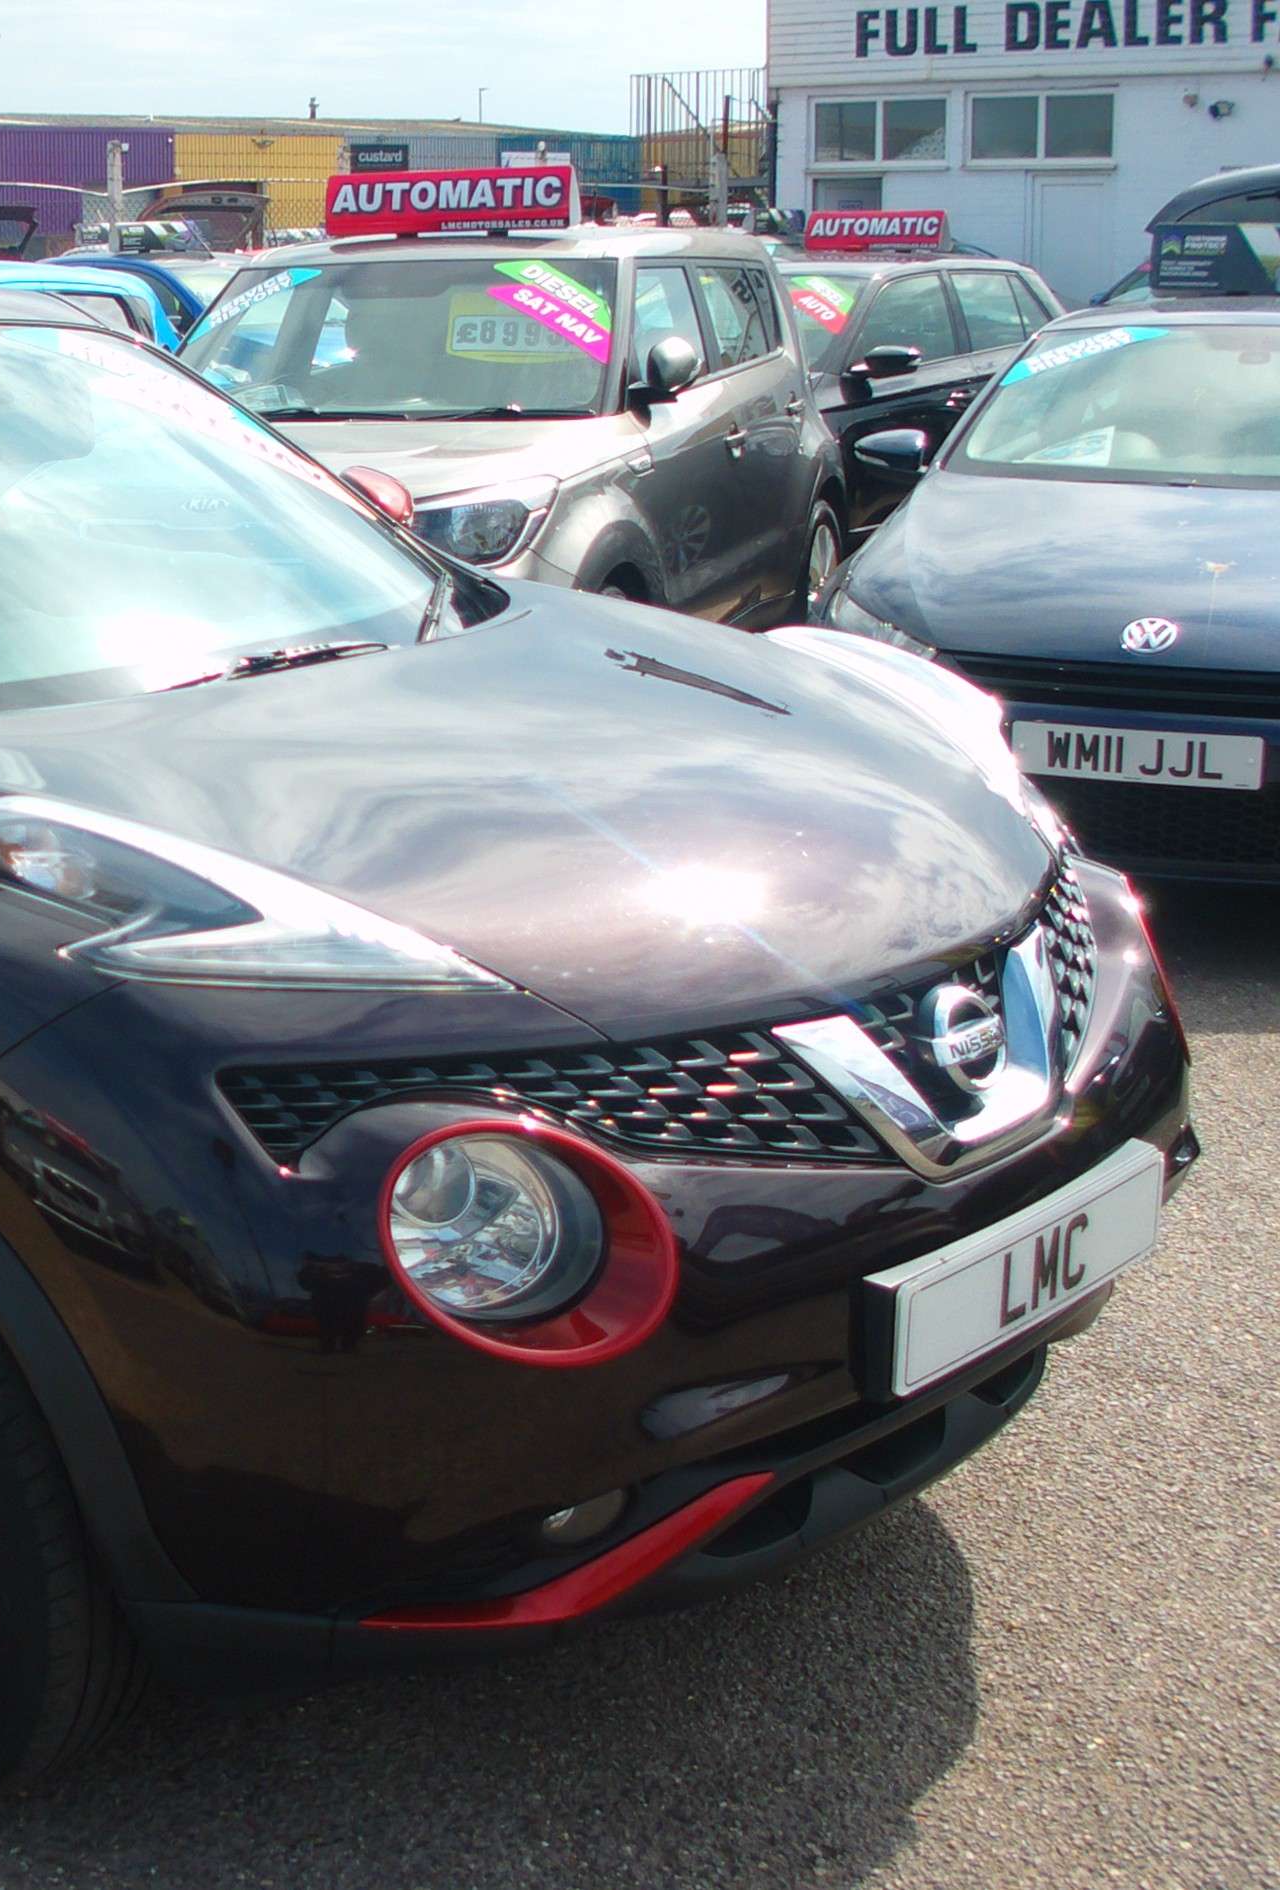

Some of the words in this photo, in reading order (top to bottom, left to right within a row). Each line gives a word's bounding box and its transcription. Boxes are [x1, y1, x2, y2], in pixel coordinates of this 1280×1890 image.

[856, 5, 977, 57] FULL
[1004, 0, 1228, 52] DEALER
[1251, 0, 1280, 42] F
[358, 150, 403, 163] custard
[332, 176, 562, 213] AUTOMATIC
[810, 216, 939, 236] AUTOMATIC
[521, 263, 601, 320] DIESEL
[798, 295, 837, 320] AUTO
[512, 289, 561, 316] SAT
[555, 313, 604, 344] NAV
[1047, 731, 1123, 773] WM11
[1139, 738, 1222, 780] JJL
[1000, 1213, 1088, 1328] LMC
